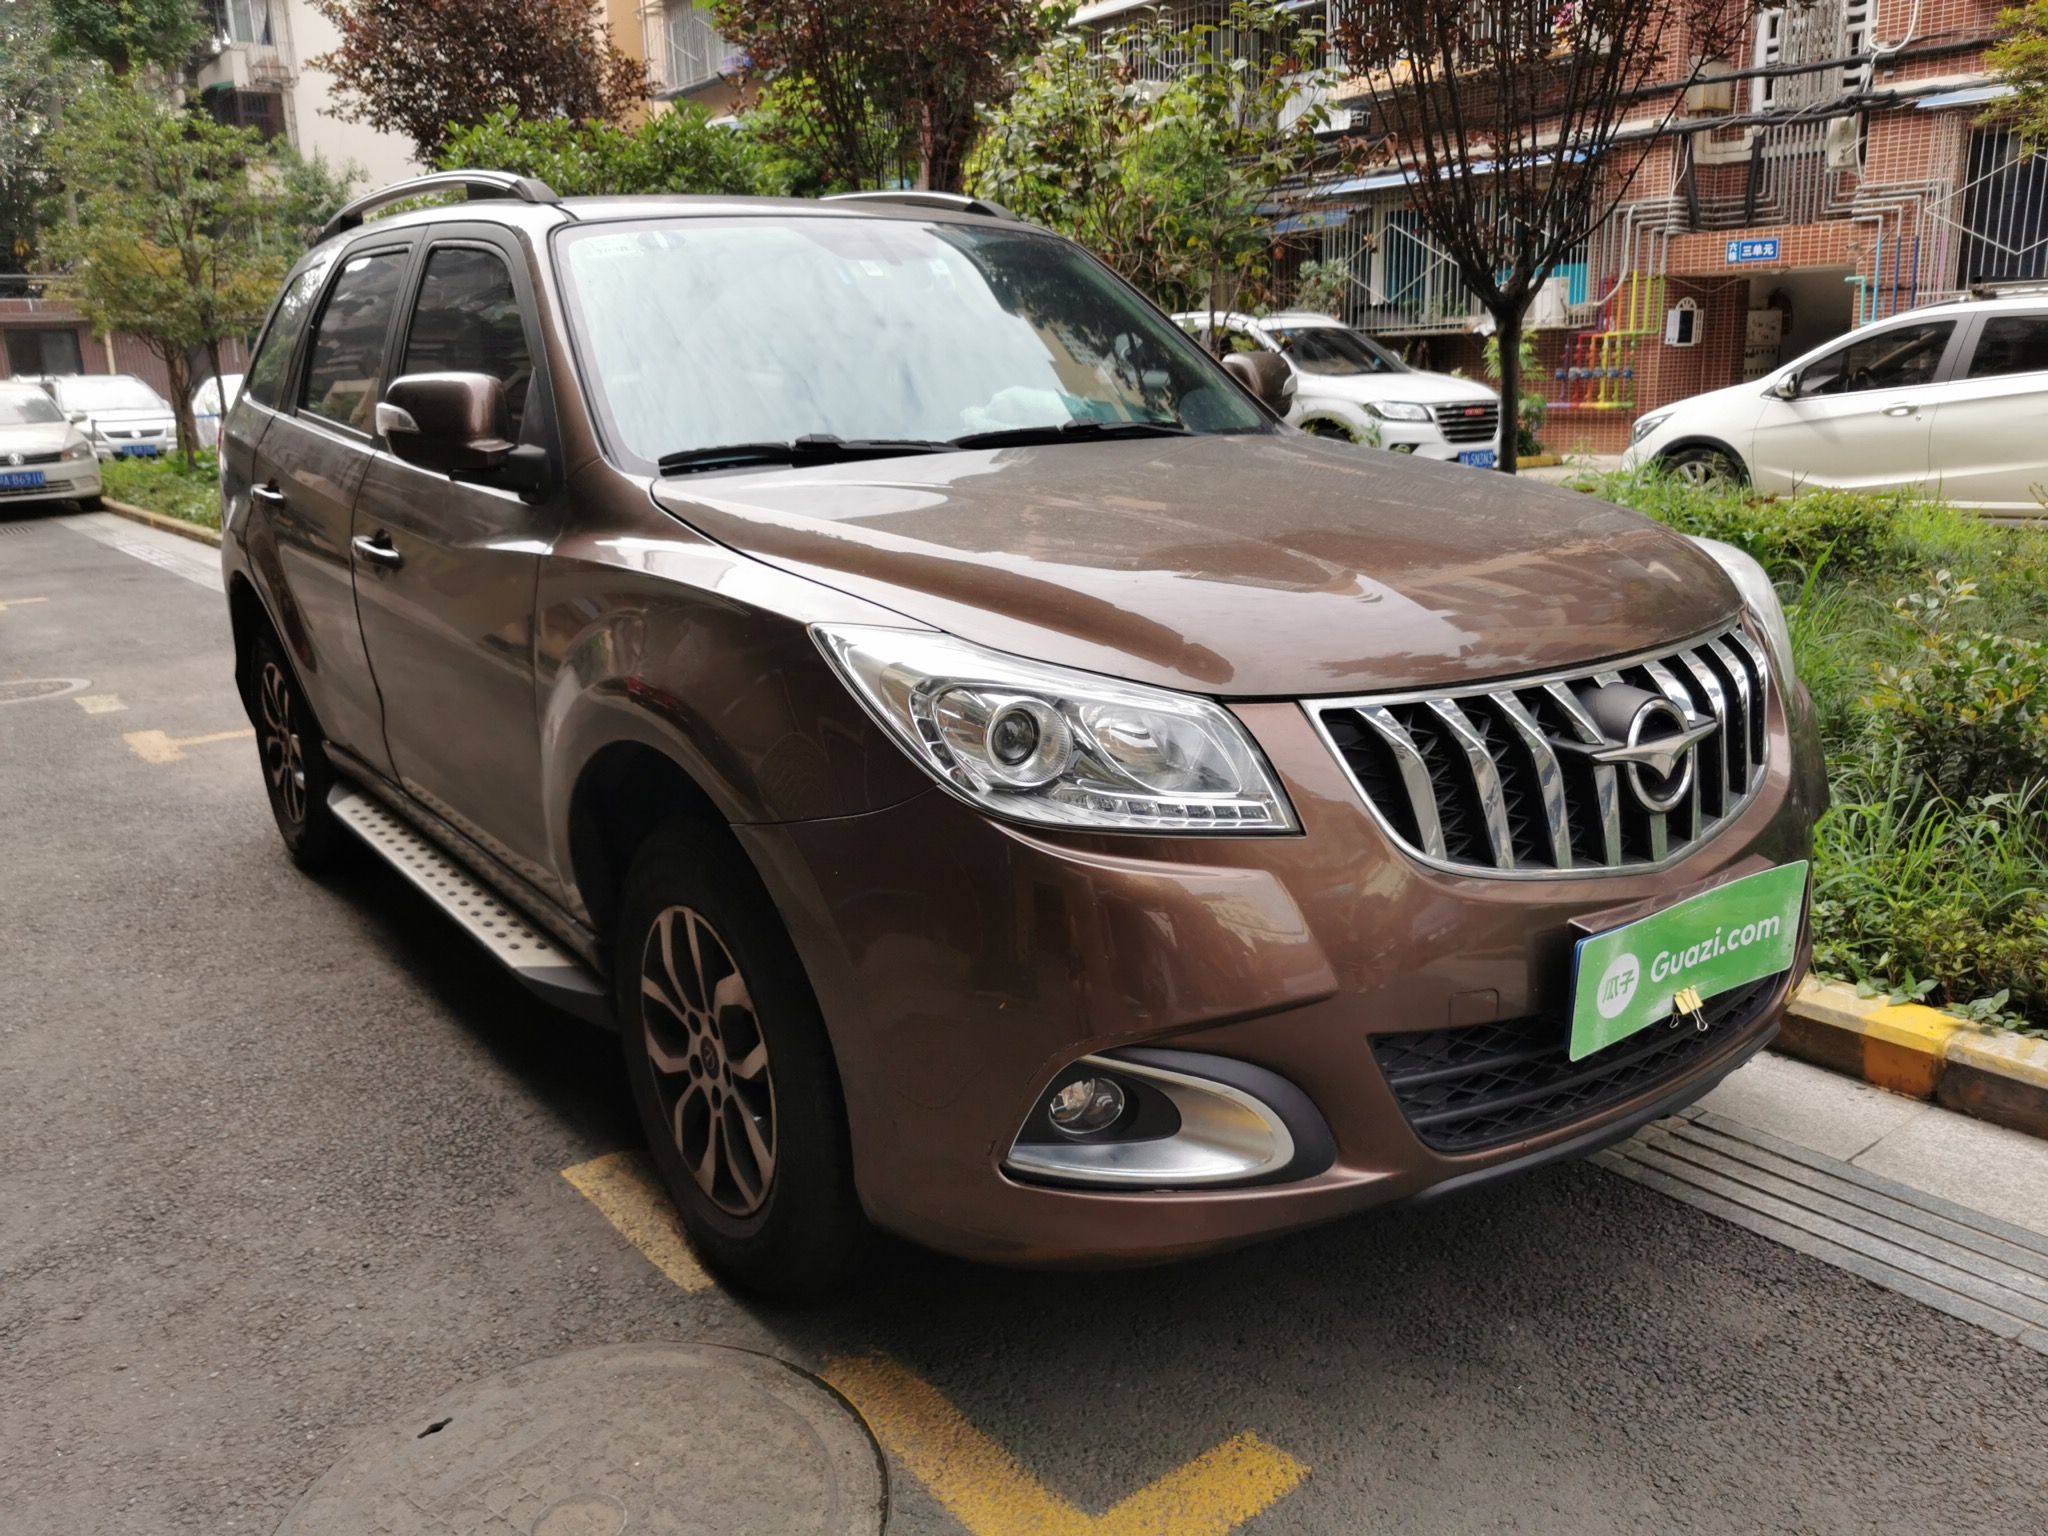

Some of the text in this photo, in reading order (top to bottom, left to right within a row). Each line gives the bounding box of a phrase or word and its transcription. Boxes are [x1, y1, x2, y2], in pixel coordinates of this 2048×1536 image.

[1741, 243, 1774, 257] 三单元
[1651, 915, 1780, 983] Guazi.com
[1602, 969, 1635, 1004] 瓜子
